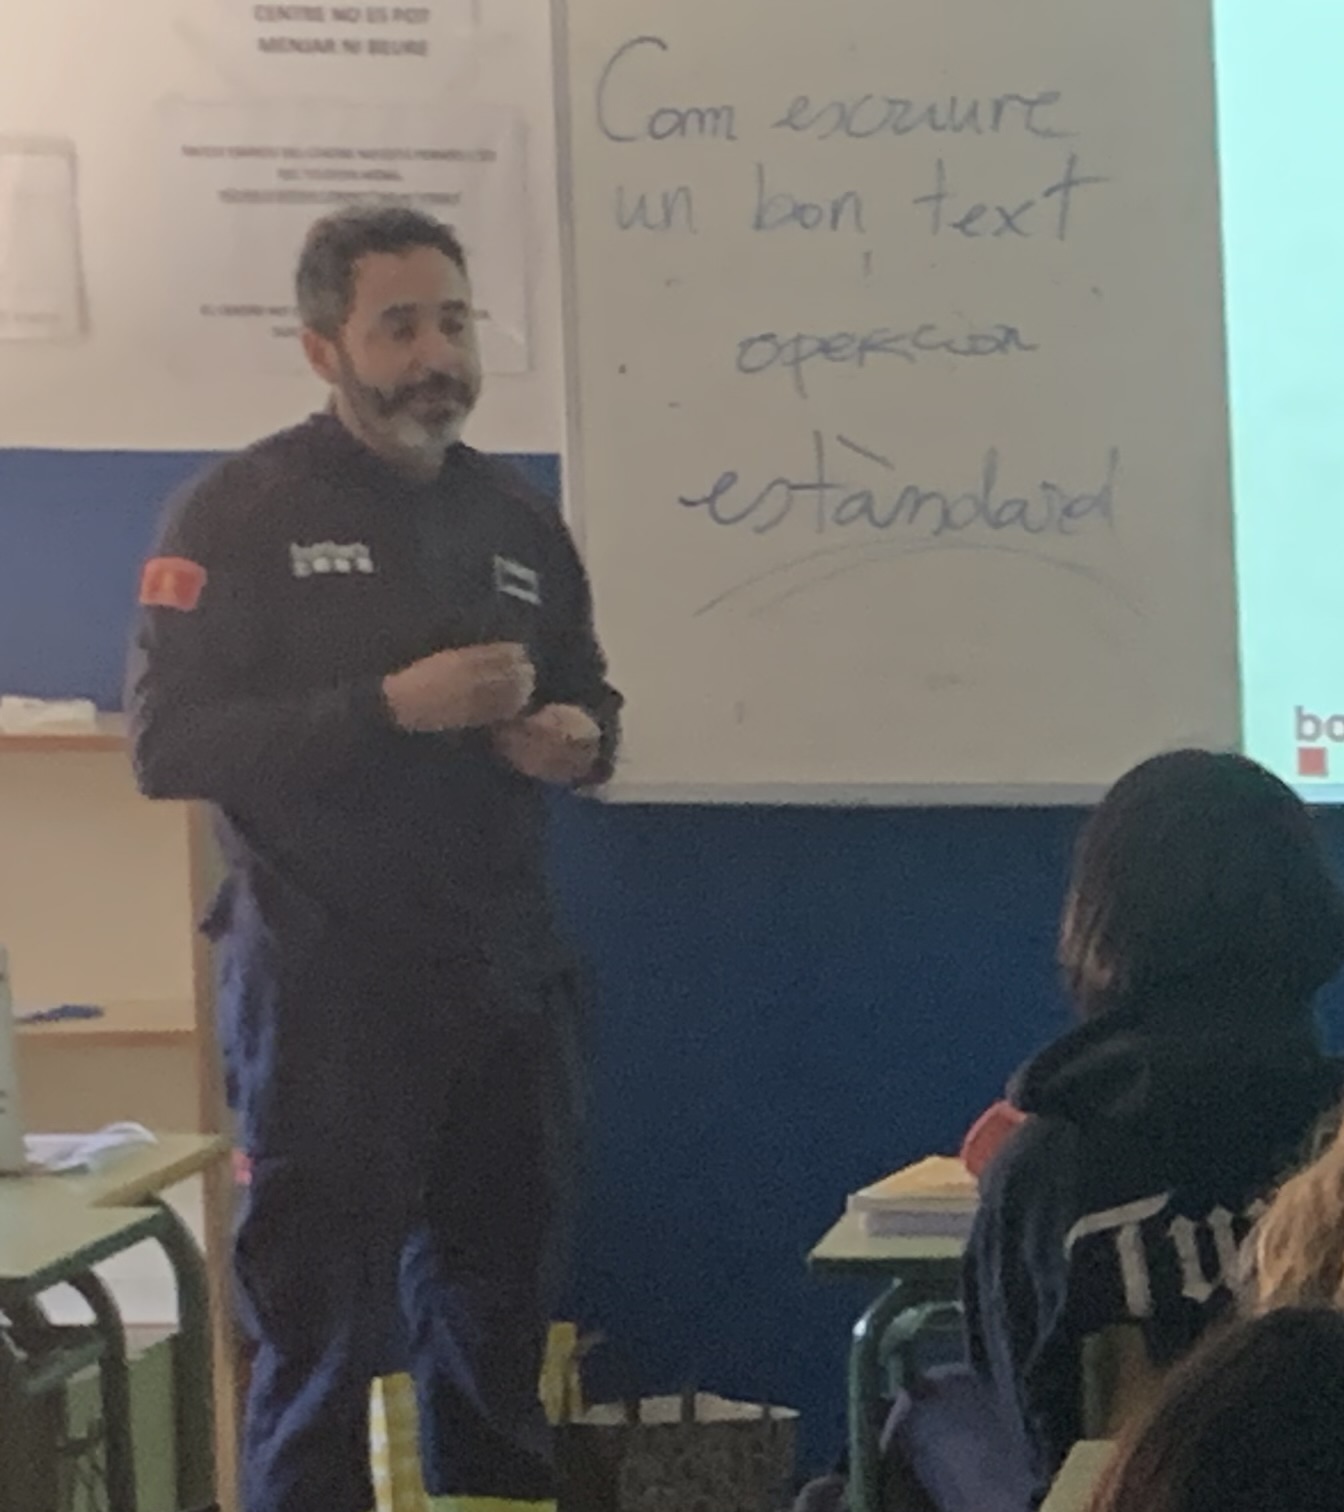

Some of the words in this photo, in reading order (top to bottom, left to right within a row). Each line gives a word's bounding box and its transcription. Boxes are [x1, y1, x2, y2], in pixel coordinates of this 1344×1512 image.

[614, 183, 698, 235] un
[750, 160, 866, 234] bon
[911, 152, 1112, 242] text
